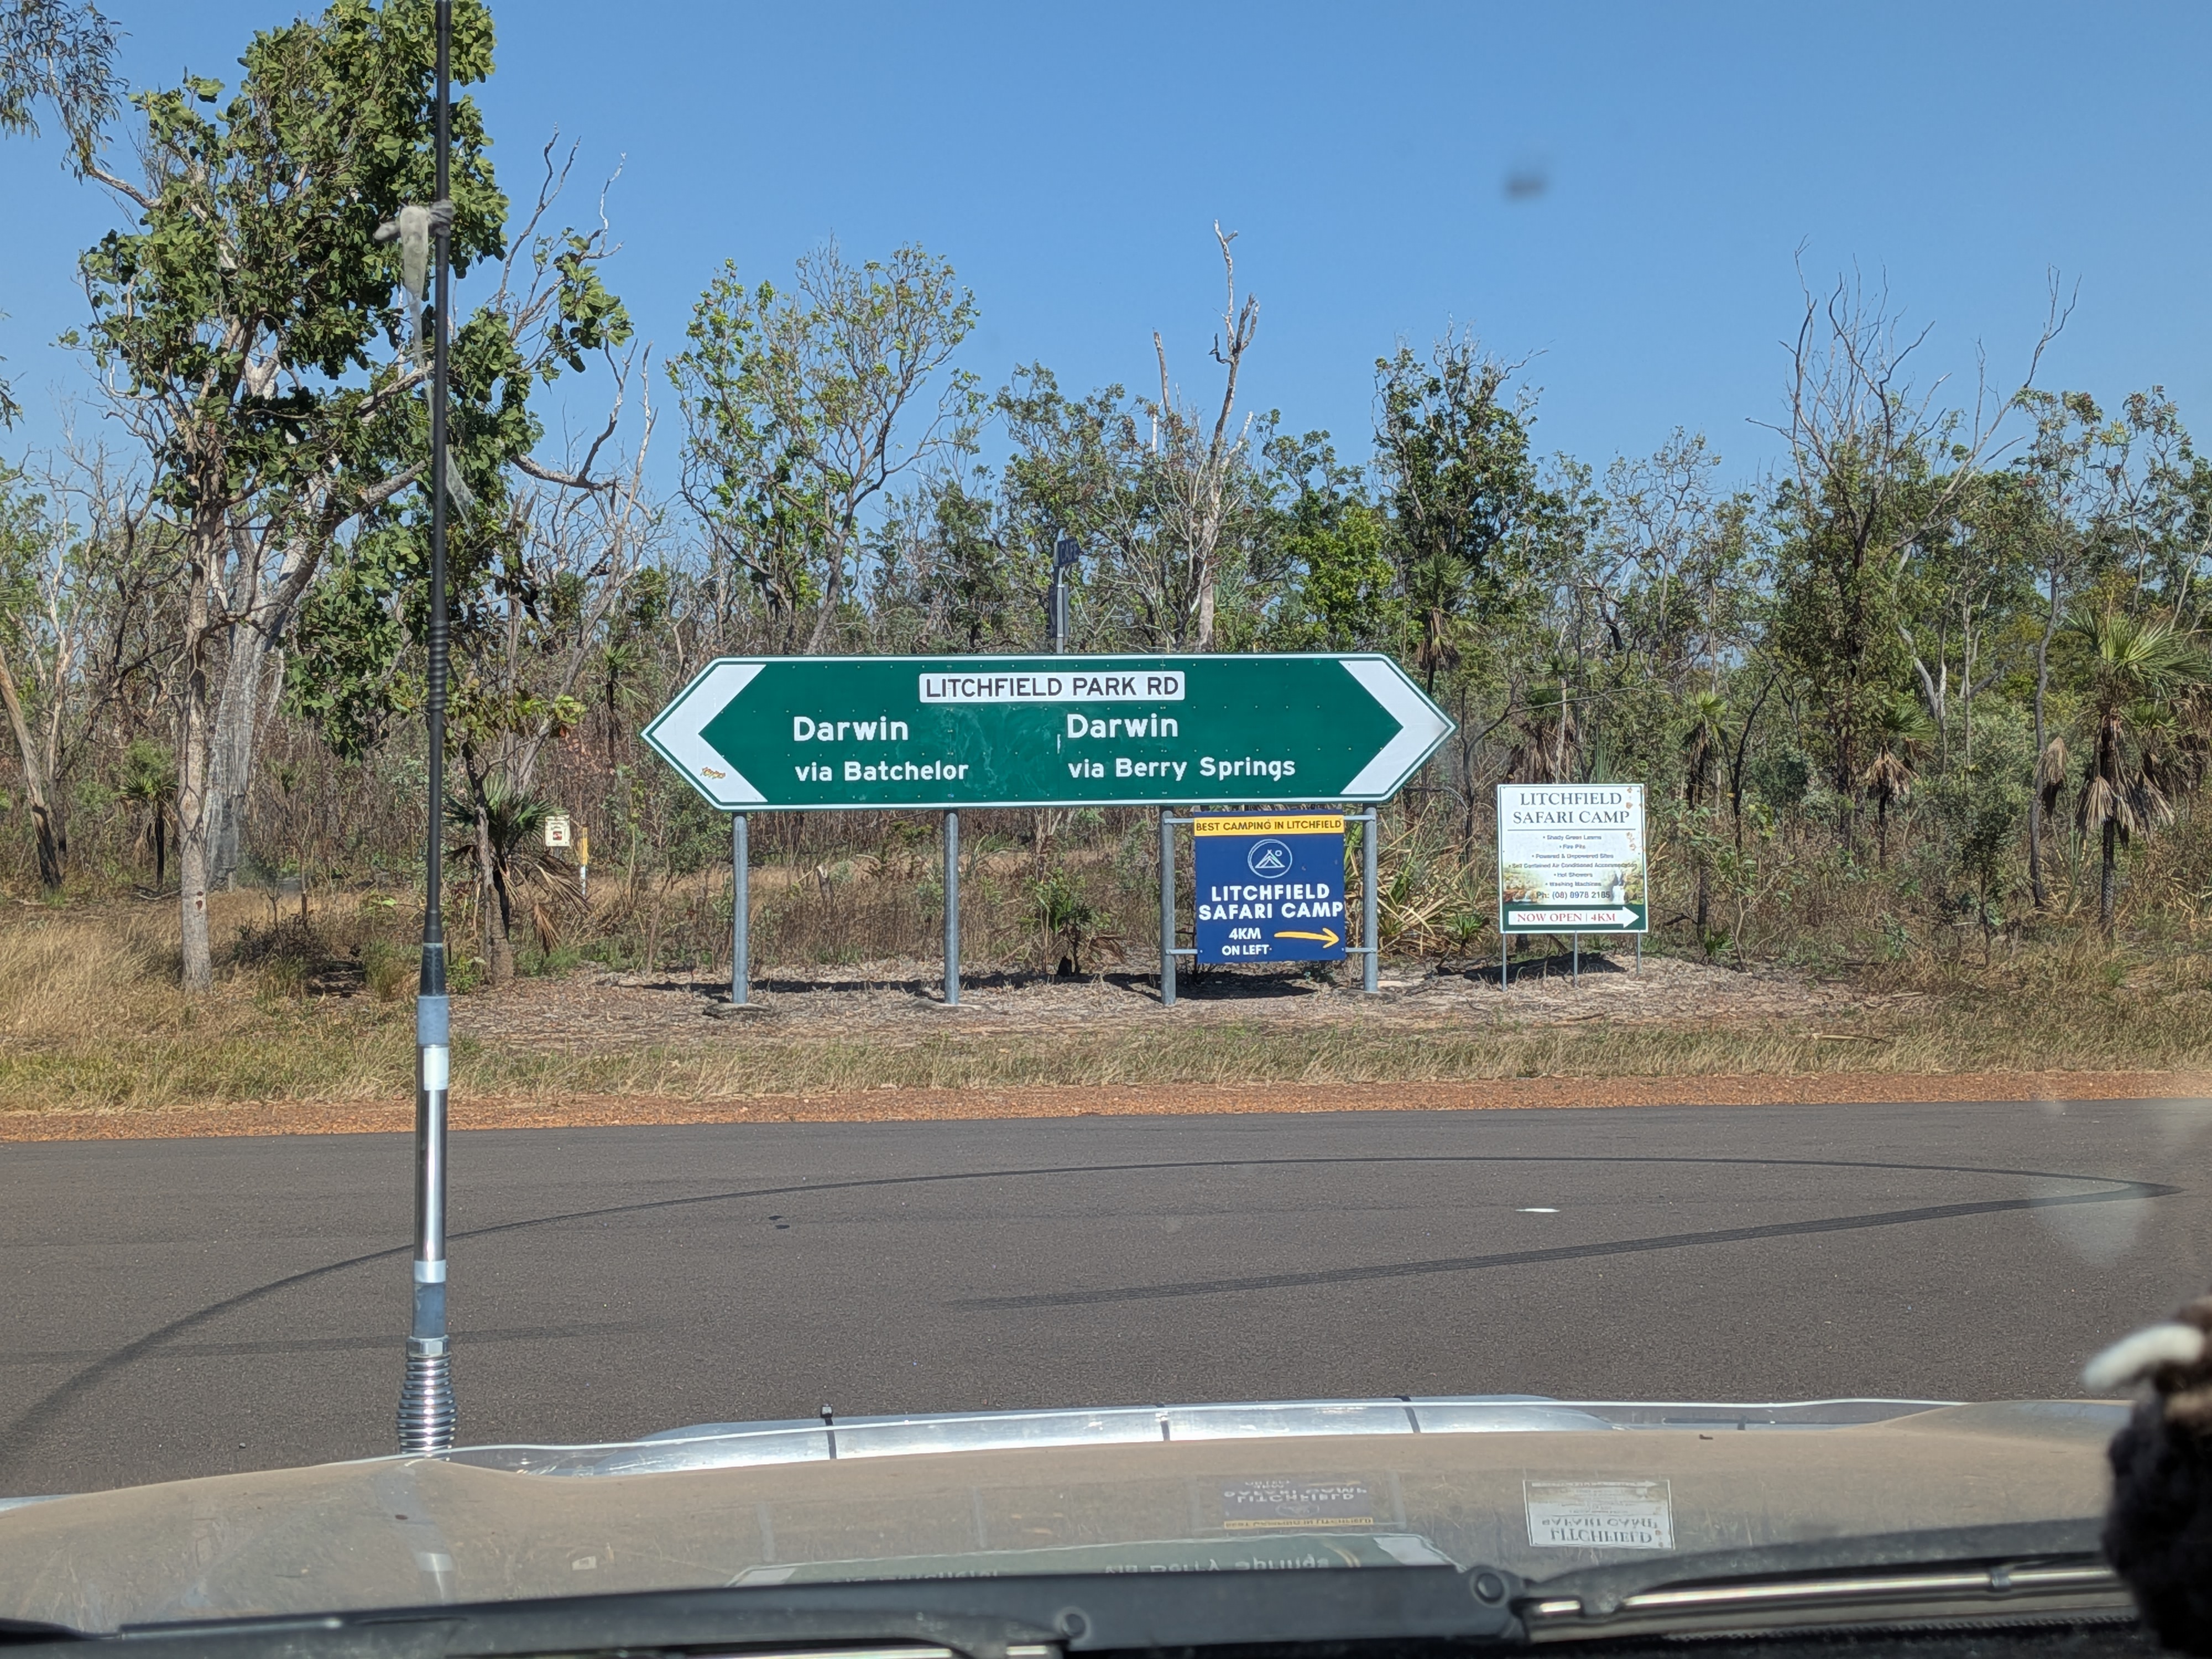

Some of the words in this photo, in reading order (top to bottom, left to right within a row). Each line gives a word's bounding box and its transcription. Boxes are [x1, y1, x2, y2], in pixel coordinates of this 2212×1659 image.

[926, 677, 1062, 698] LITCHFIELD
[1073, 677, 1136, 696] PARK
[1147, 676, 1178, 696] RD
[793, 716, 909, 742] Darwin
[1067, 713, 1178, 738] Darwin
[795, 761, 832, 781] via
[844, 760, 968, 781] Batchelor
[1068, 758, 1104, 778] via
[1115, 758, 1187, 781] Berry
[1199, 757, 1296, 781] Springs
[1520, 792, 1621, 806] LITCHFIELD
[1196, 822, 1220, 831] BEST
[1223, 821, 1271, 831] CAMPING
[1274, 821, 1284, 830] IN
[1287, 820, 1342, 829] LITCHFIELD
[1513, 811, 1573, 824] SAFARI
[1579, 811, 1630, 823] CAMP
[1211, 884, 1330, 902] LITCHFIELD
[1198, 903, 1272, 920] SAFARI
[1281, 901, 1343, 918] CAMP
[1517, 913, 1546, 922] NOW
[1550, 913, 1582, 922] OPEN
[1591, 913, 1615, 922] 4KM
[1228, 927, 1261, 940] 4KM
[1222, 945, 1240, 956] ON
[1243, 945, 1267, 955] LEFT
